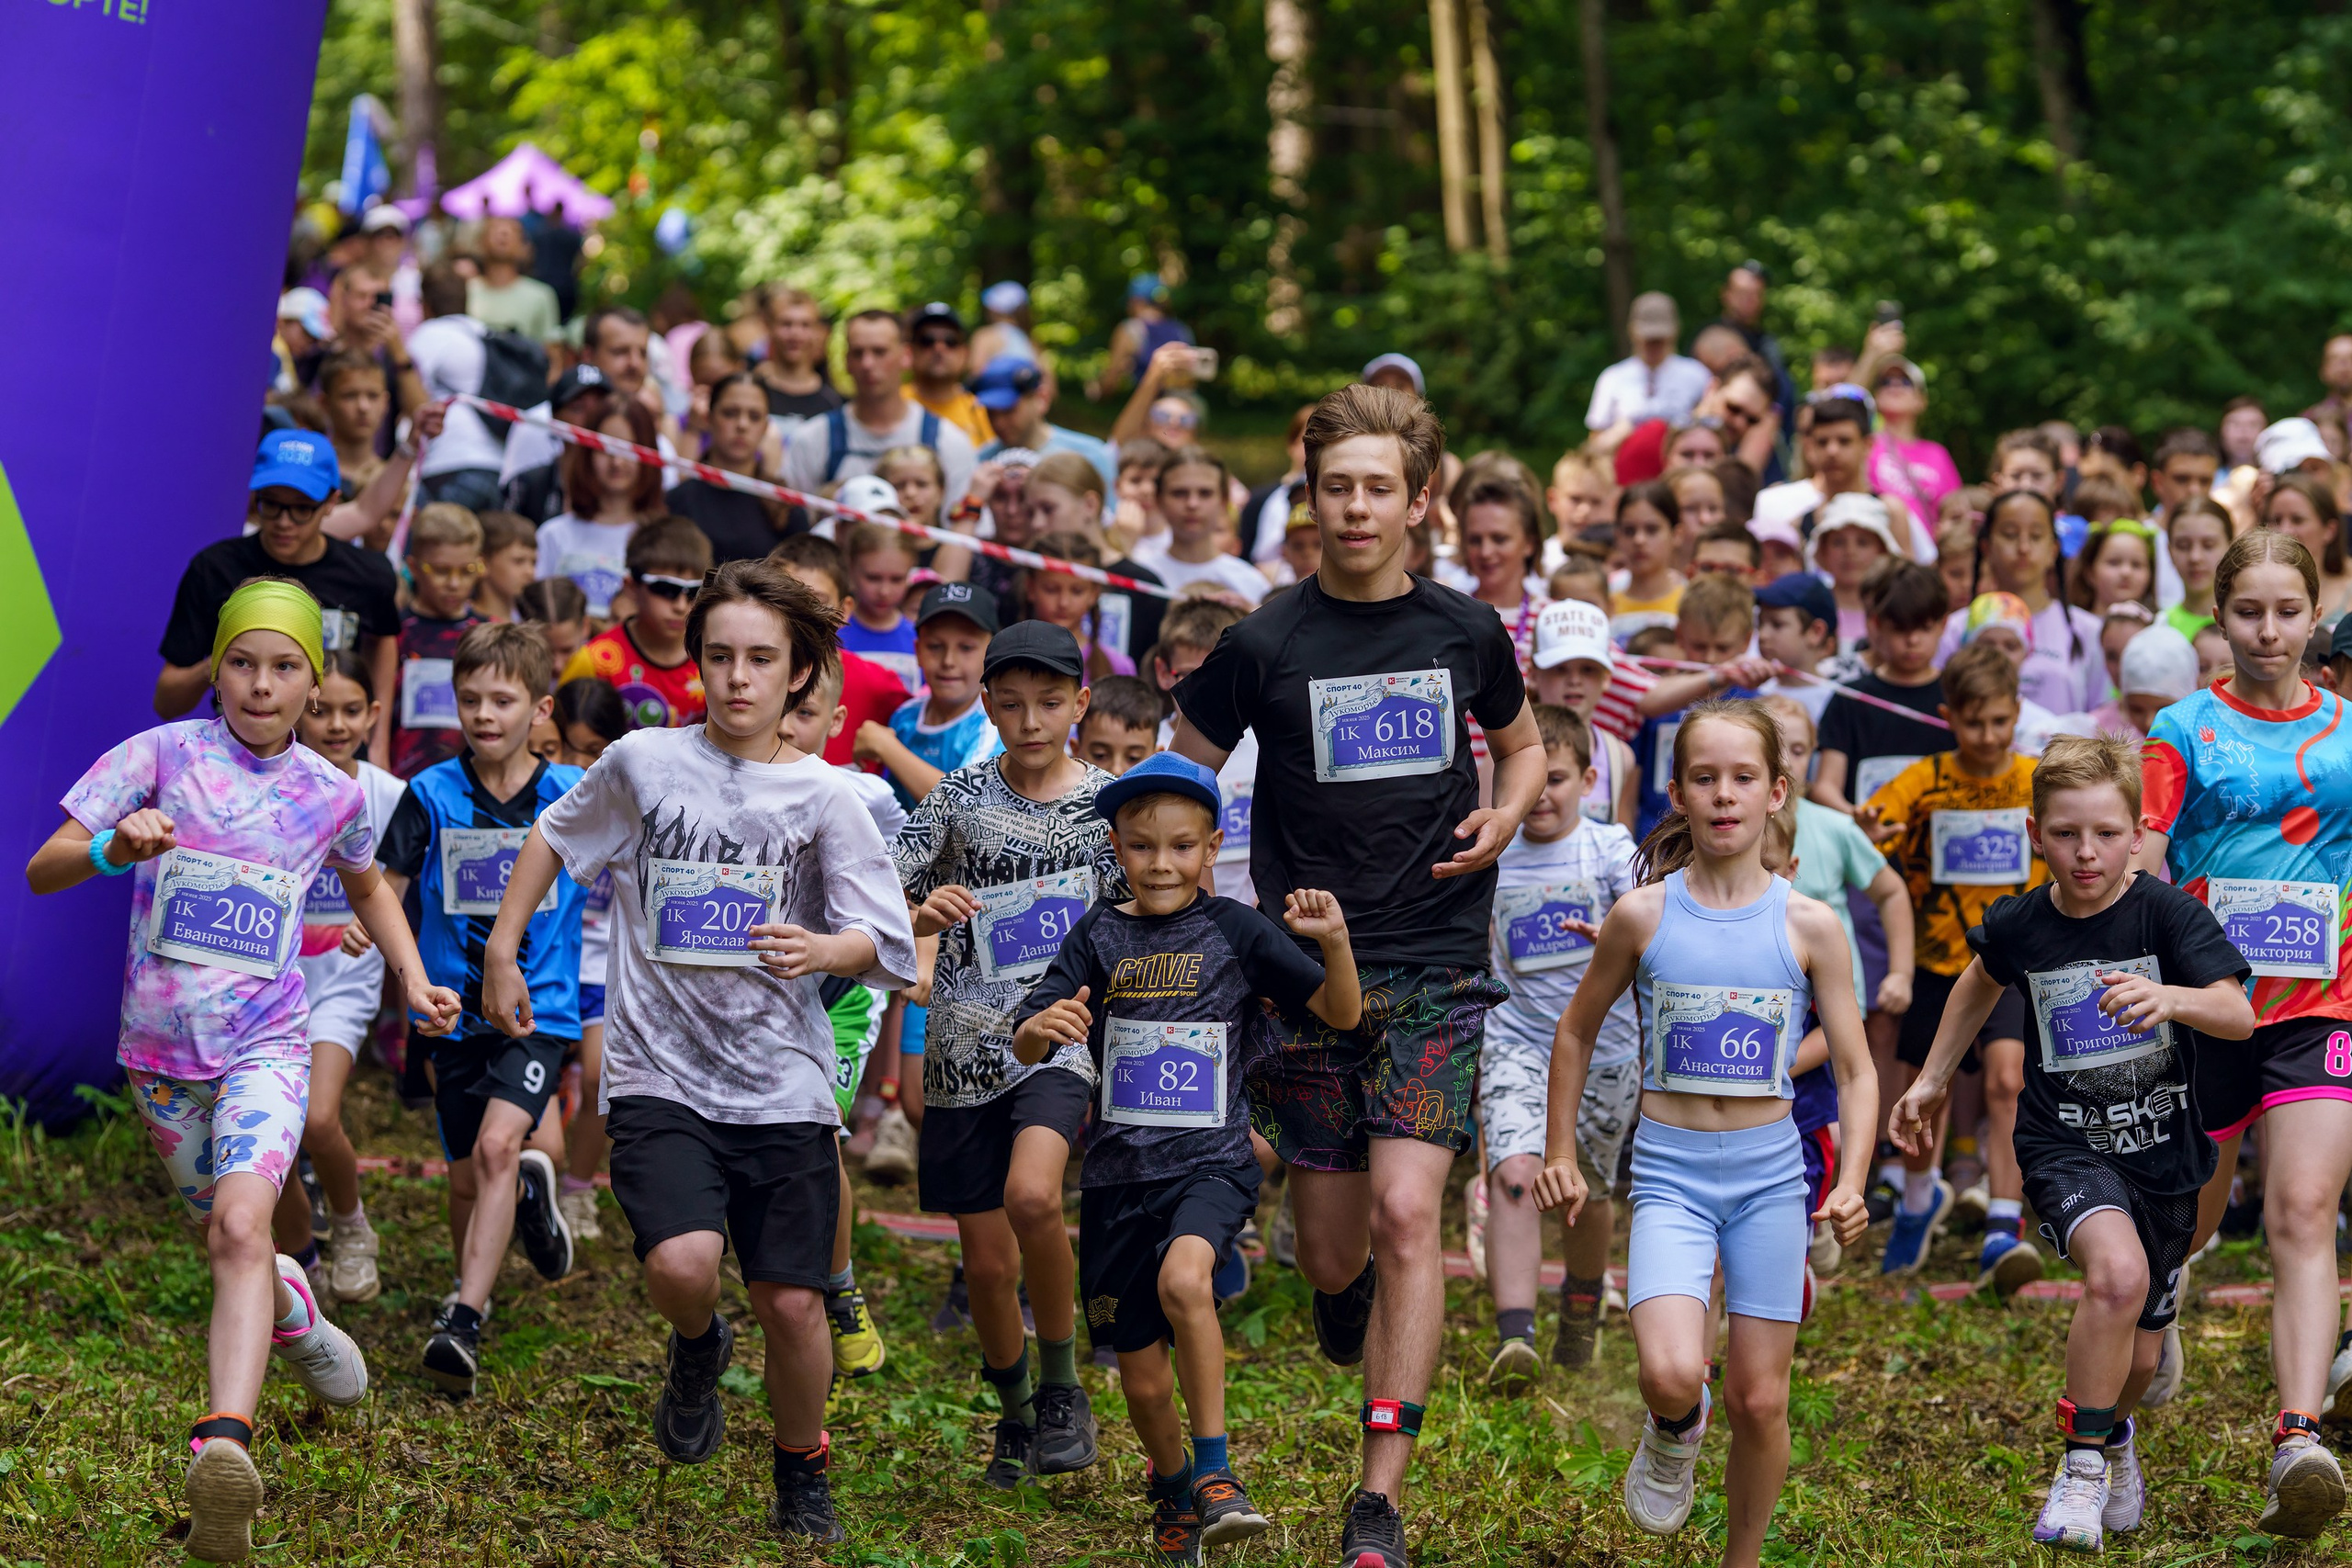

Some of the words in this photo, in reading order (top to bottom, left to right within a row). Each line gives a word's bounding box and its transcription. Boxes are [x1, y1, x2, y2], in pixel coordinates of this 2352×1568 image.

[1326, 684, 1351, 693] СПОРТ
[1328, 698, 1378, 720] Лукоморье
[1339, 726, 1361, 741] 1K
[1375, 708, 1434, 742] 618
[1358, 744, 1420, 761] Максим
[978, 809, 1004, 822] STREIFEN
[995, 807, 1018, 818] BANDES
[980, 818, 1003, 829] STRIPES
[1023, 833, 1039, 841] WITH
[1973, 834, 2018, 861] 325
[176, 854, 201, 865] СПОРТ
[498, 859, 514, 886] 8
[662, 866, 684, 874] СПОРТ
[169, 879, 226, 892] Лукоморье
[660, 885, 709, 899] Лукоморье
[981, 891, 1003, 900] СПОРТ
[306, 899, 346, 913] арина
[984, 901, 1030, 926] Лукоморье
[2222, 901, 2272, 916] Лукоморье
[173, 899, 198, 918] 1K
[210, 897, 276, 940] 208
[666, 908, 686, 923] 1K
[700, 900, 763, 932] 207
[996, 928, 1017, 943] 1K
[1039, 907, 1072, 939] 81
[2230, 924, 2250, 938] 1K
[2264, 916, 2320, 945] 258
[173, 921, 270, 956] Евангелина
[679, 930, 745, 948] Ярослав
[1526, 936, 1577, 954] Андрей
[1017, 942, 1060, 961] Дани
[2239, 943, 2312, 962] Виктория
[1179, 989, 1198, 998] SPORT
[1666, 990, 1690, 998] СПОРТ
[2045, 990, 2088, 1010] Лукоморье
[951, 1004, 978, 1018] STREIFEN
[969, 1001, 991, 1014] BANDES
[956, 1014, 977, 1025] STRIPES
[1665, 1010, 1716, 1024] Лукоморье
[2054, 1018, 2074, 1032] 1K
[1114, 1025, 1132, 1033] СПОРТ
[1672, 1034, 1692, 1050] 1K
[1720, 1027, 1761, 1060] 66
[1679, 1056, 1764, 1076] Анастасия
[523, 1060, 546, 1094] 9
[1117, 1069, 1135, 1084] 1K
[1159, 1061, 1199, 1091] 82
[1140, 1090, 1182, 1107] Иван
[2059, 1083, 2188, 1131] BASKET
[2086, 1122, 2170, 1154] BALL
